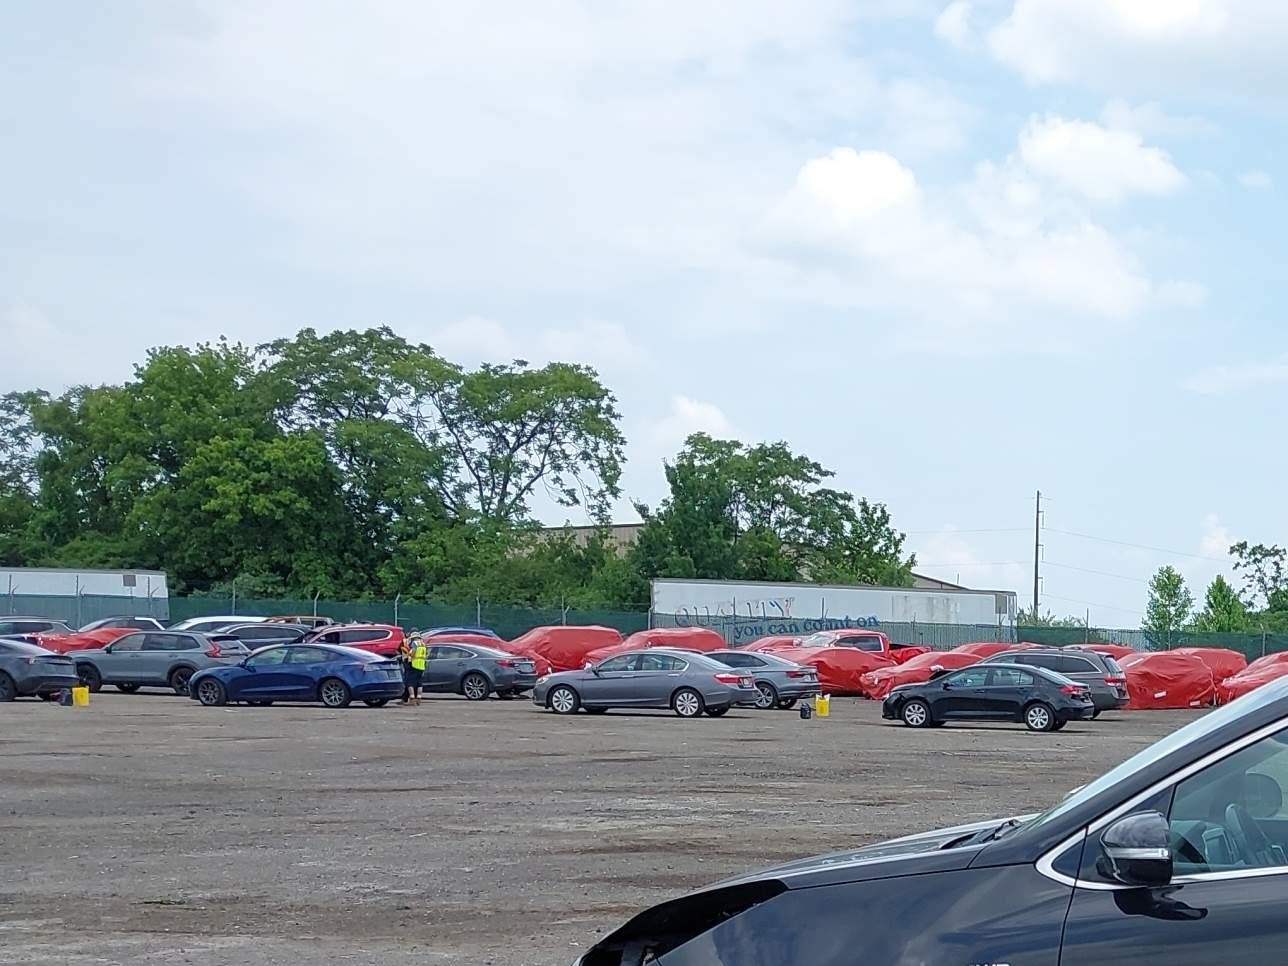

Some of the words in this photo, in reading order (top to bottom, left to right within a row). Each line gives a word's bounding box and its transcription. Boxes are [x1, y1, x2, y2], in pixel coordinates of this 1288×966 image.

[734, 624, 763, 640] you
[768, 621, 799, 634] can
[856, 614, 881, 628] on
